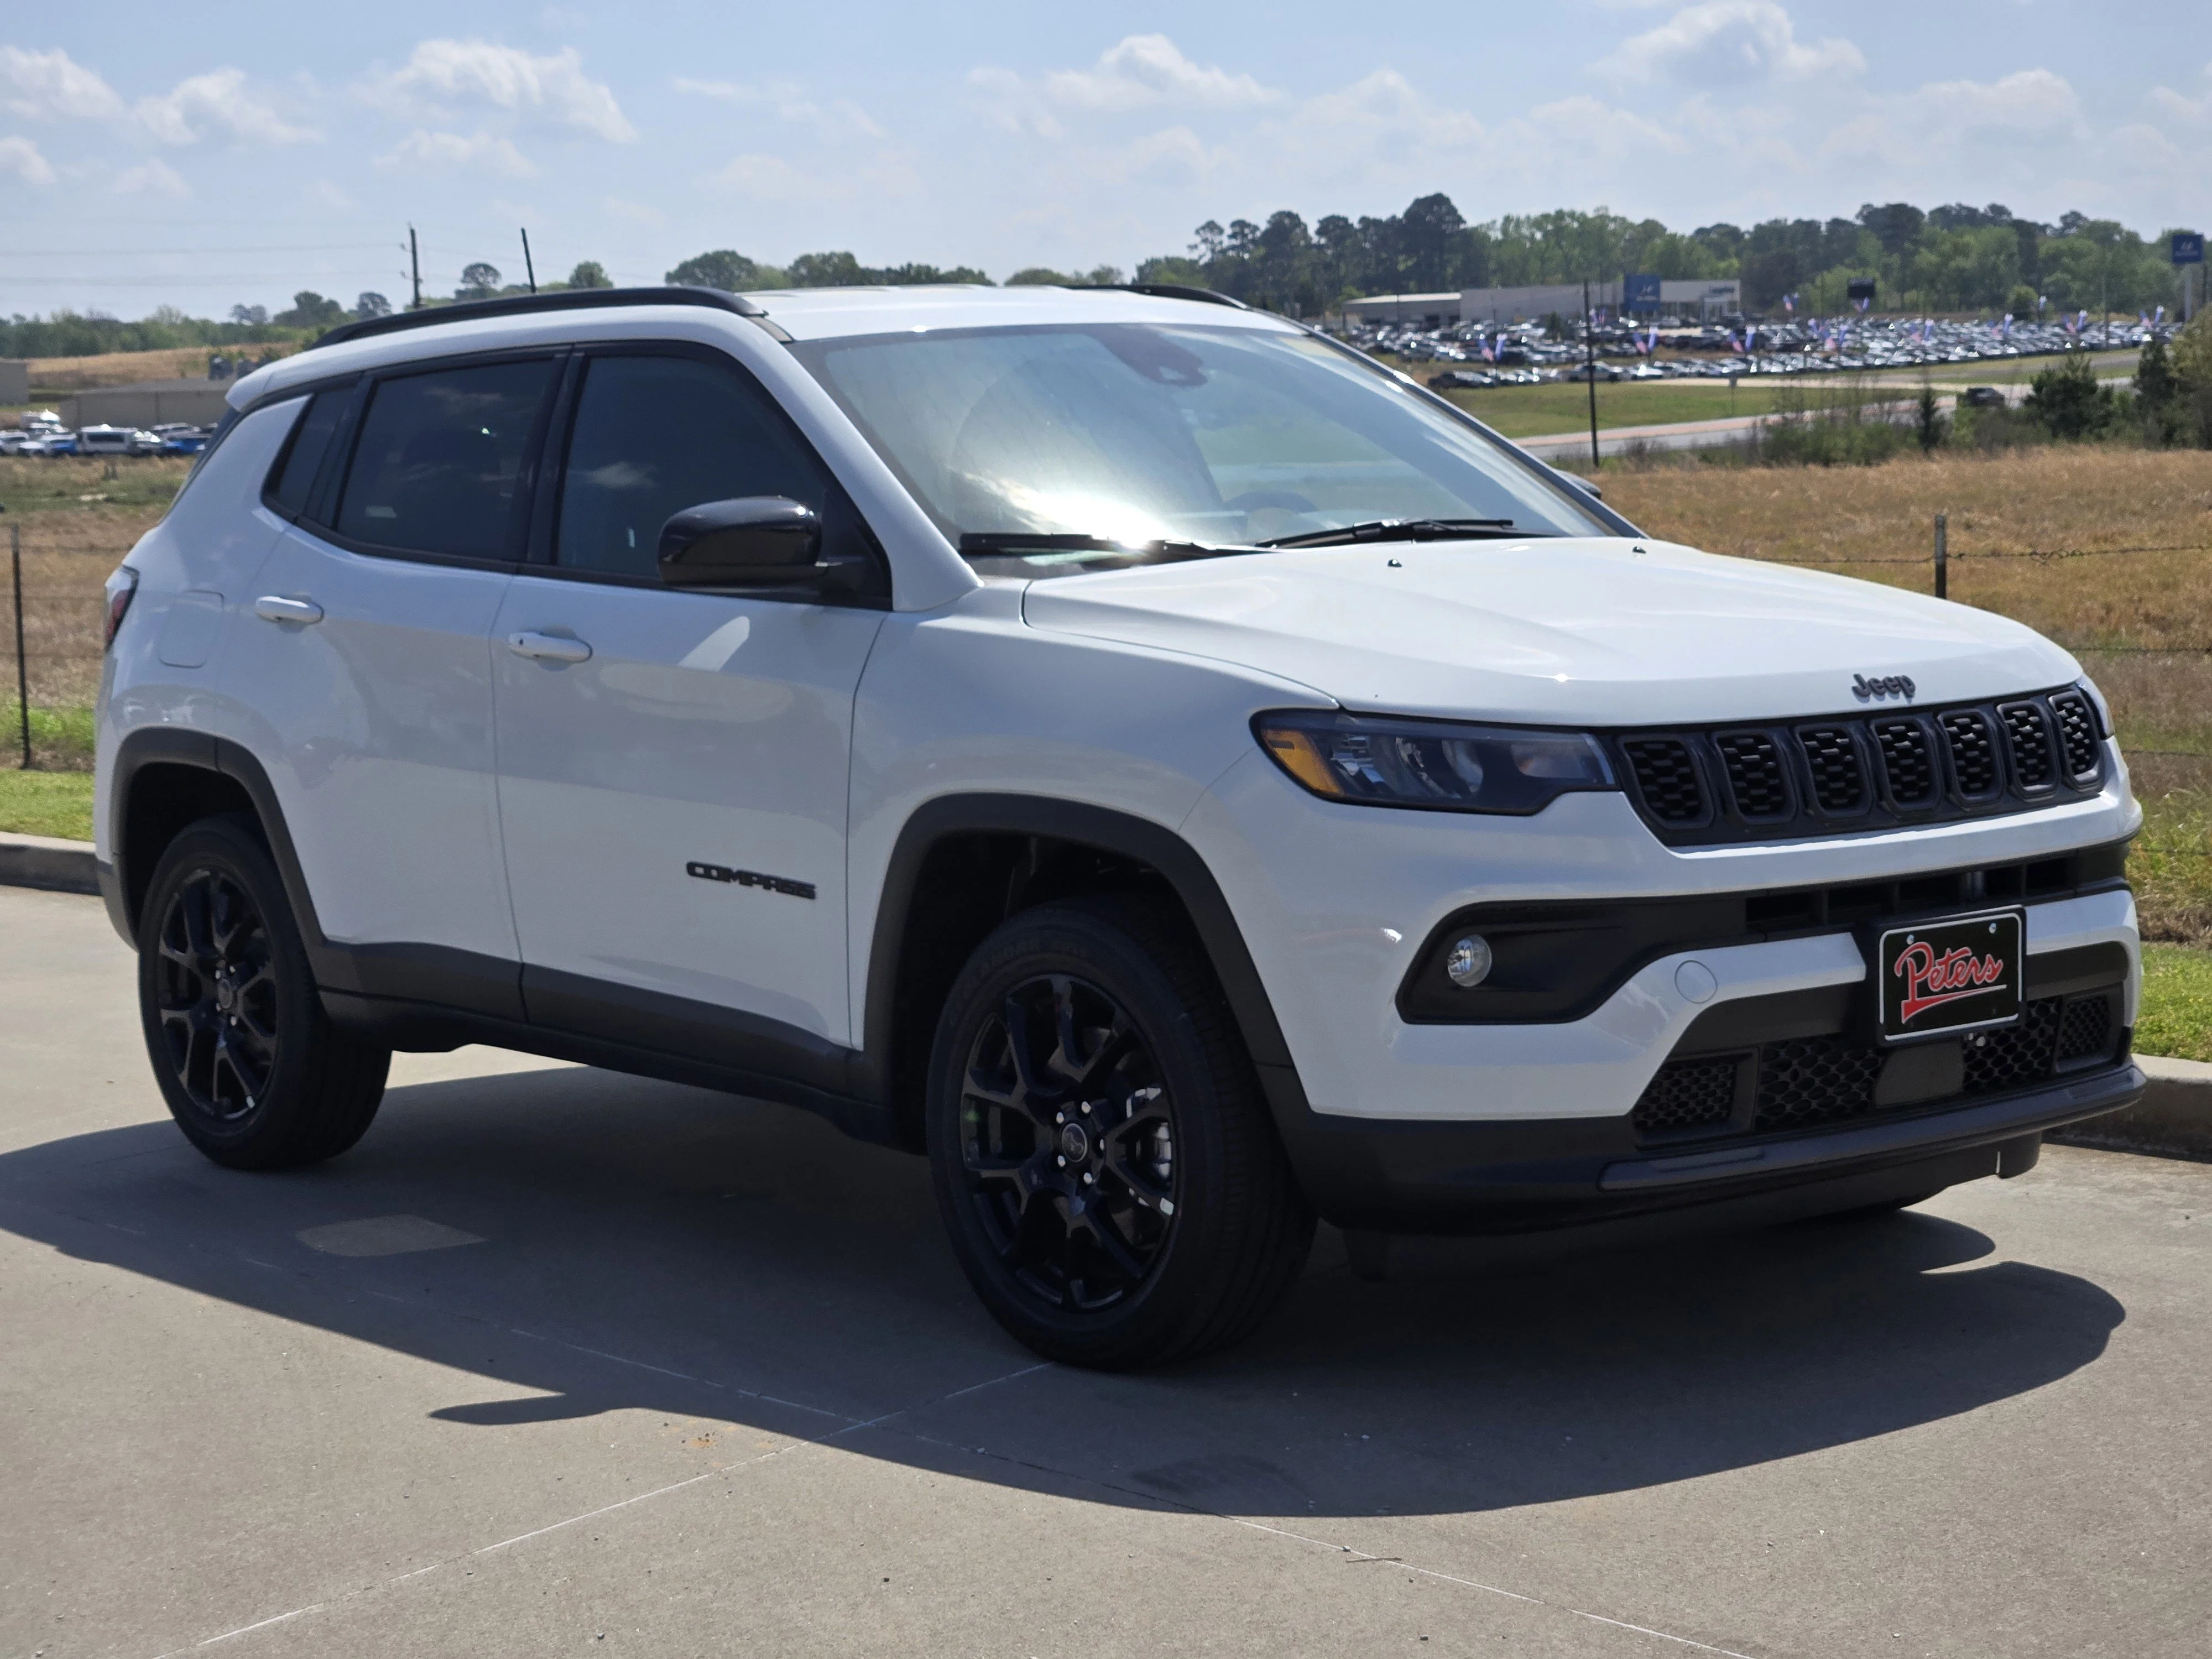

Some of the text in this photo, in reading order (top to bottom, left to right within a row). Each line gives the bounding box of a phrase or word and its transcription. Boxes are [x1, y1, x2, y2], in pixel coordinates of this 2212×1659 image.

[1851, 673, 1916, 698] Jeep
[686, 860, 816, 900] COMPASS
[1894, 941, 2005, 1005] Peters
